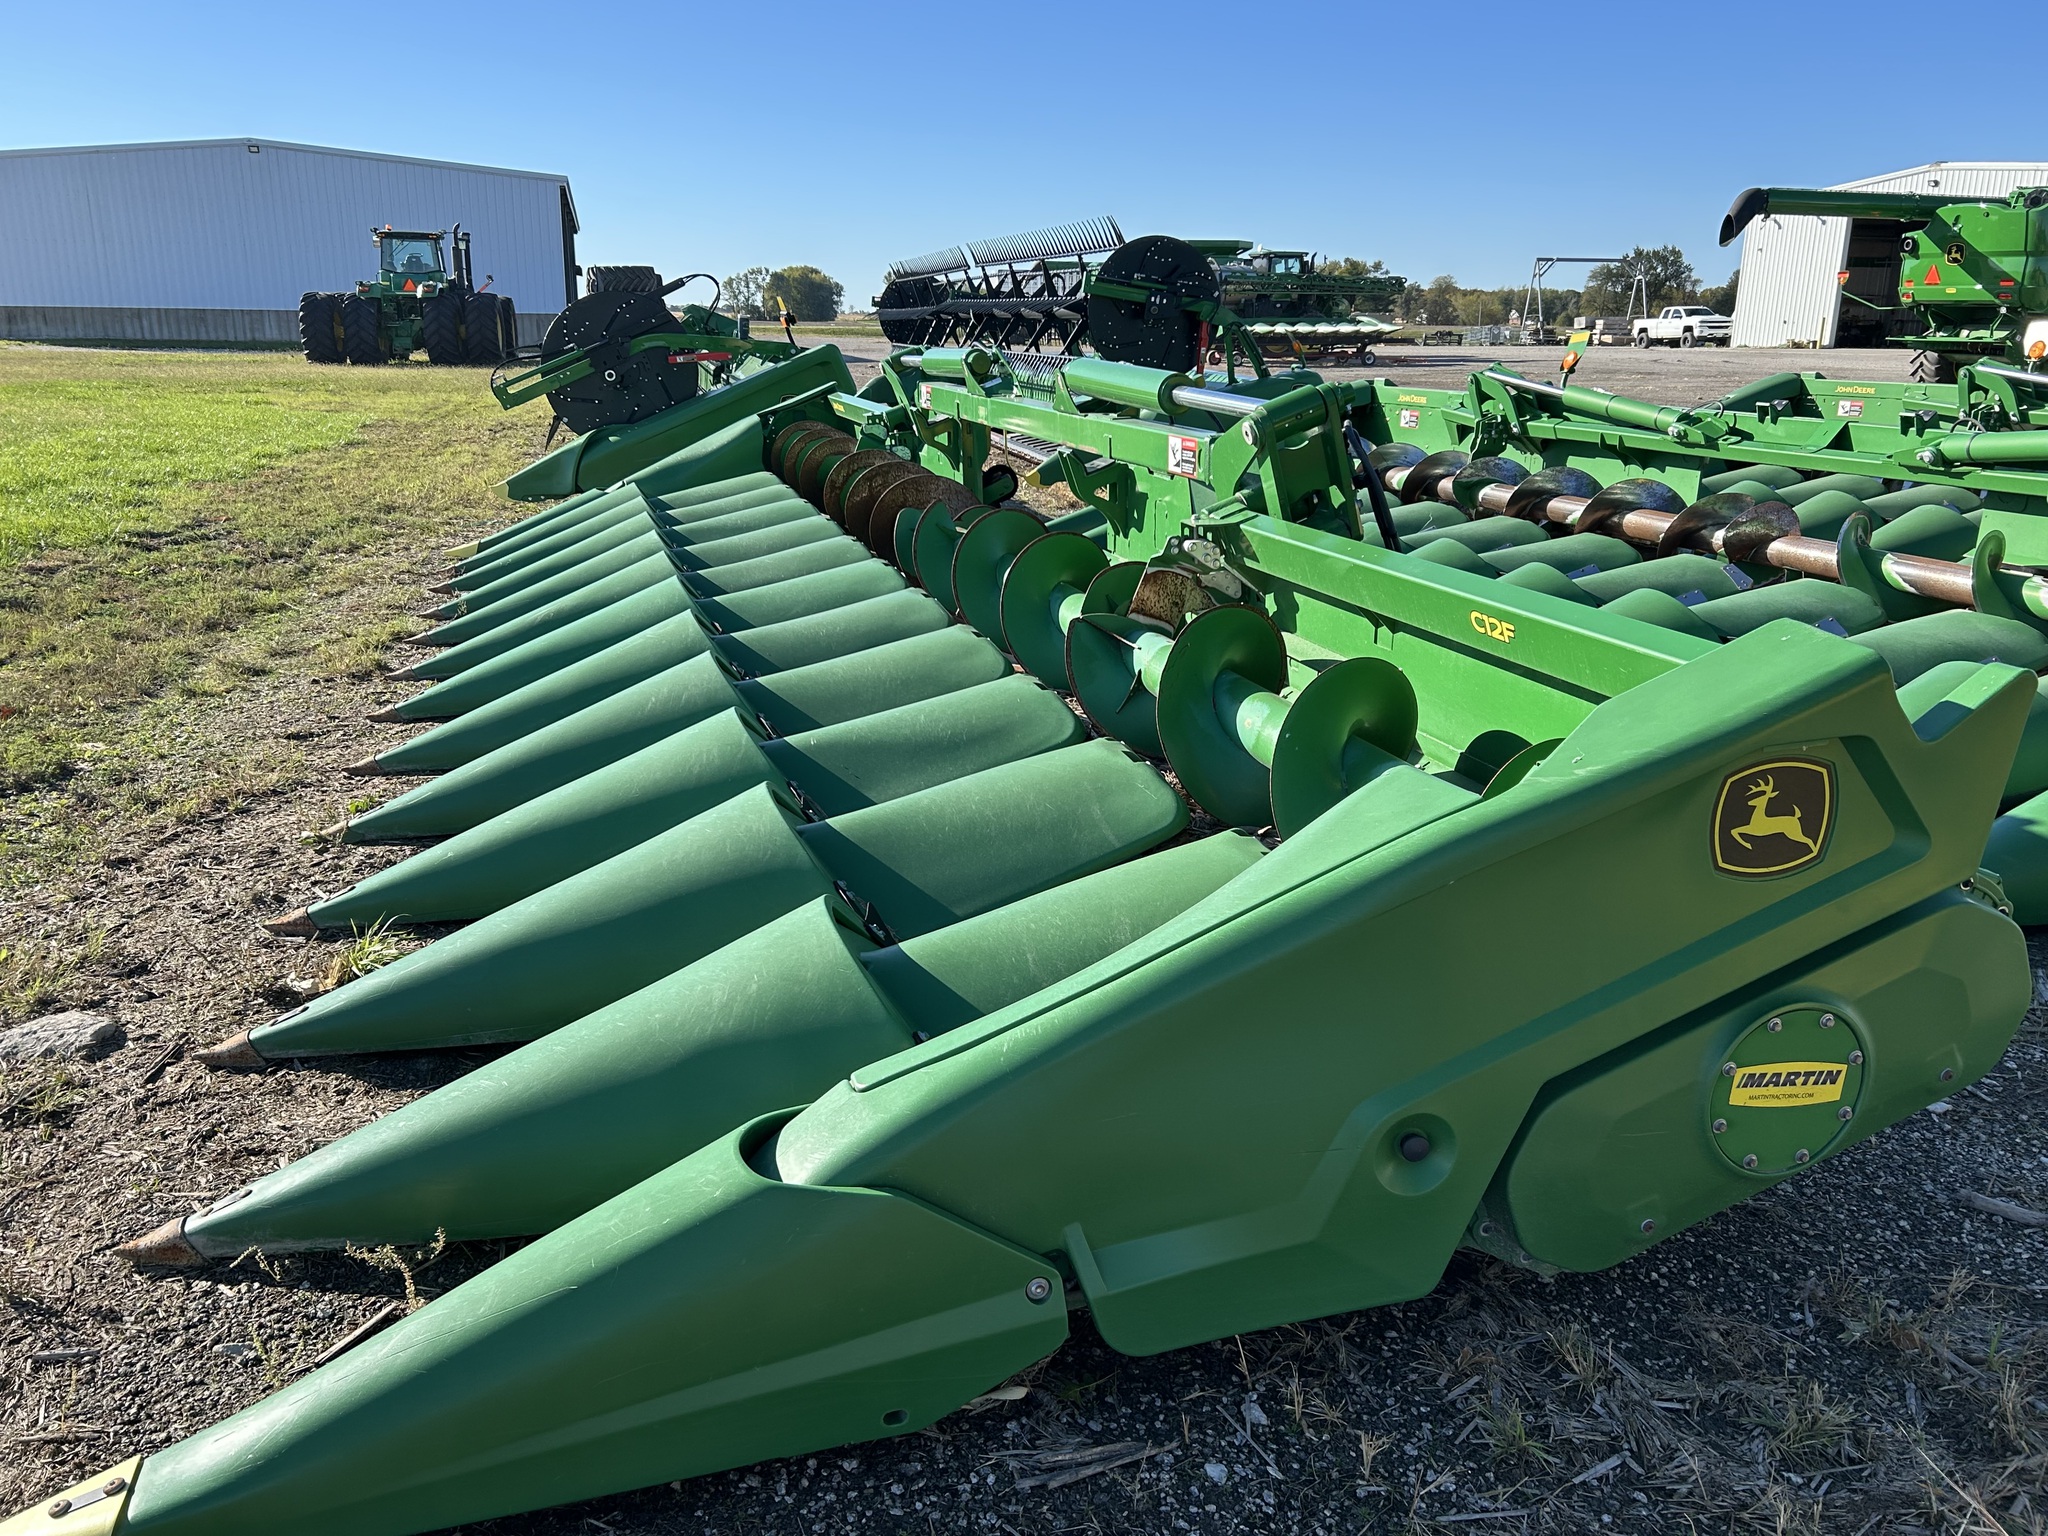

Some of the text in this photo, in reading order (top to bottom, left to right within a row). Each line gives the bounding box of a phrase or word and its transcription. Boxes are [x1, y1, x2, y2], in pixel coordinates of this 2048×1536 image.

[1835, 385, 1876, 394] JOHN DEERE
[1470, 610, 1516, 644] C12F
[1738, 1070, 1842, 1088] MARTIN
